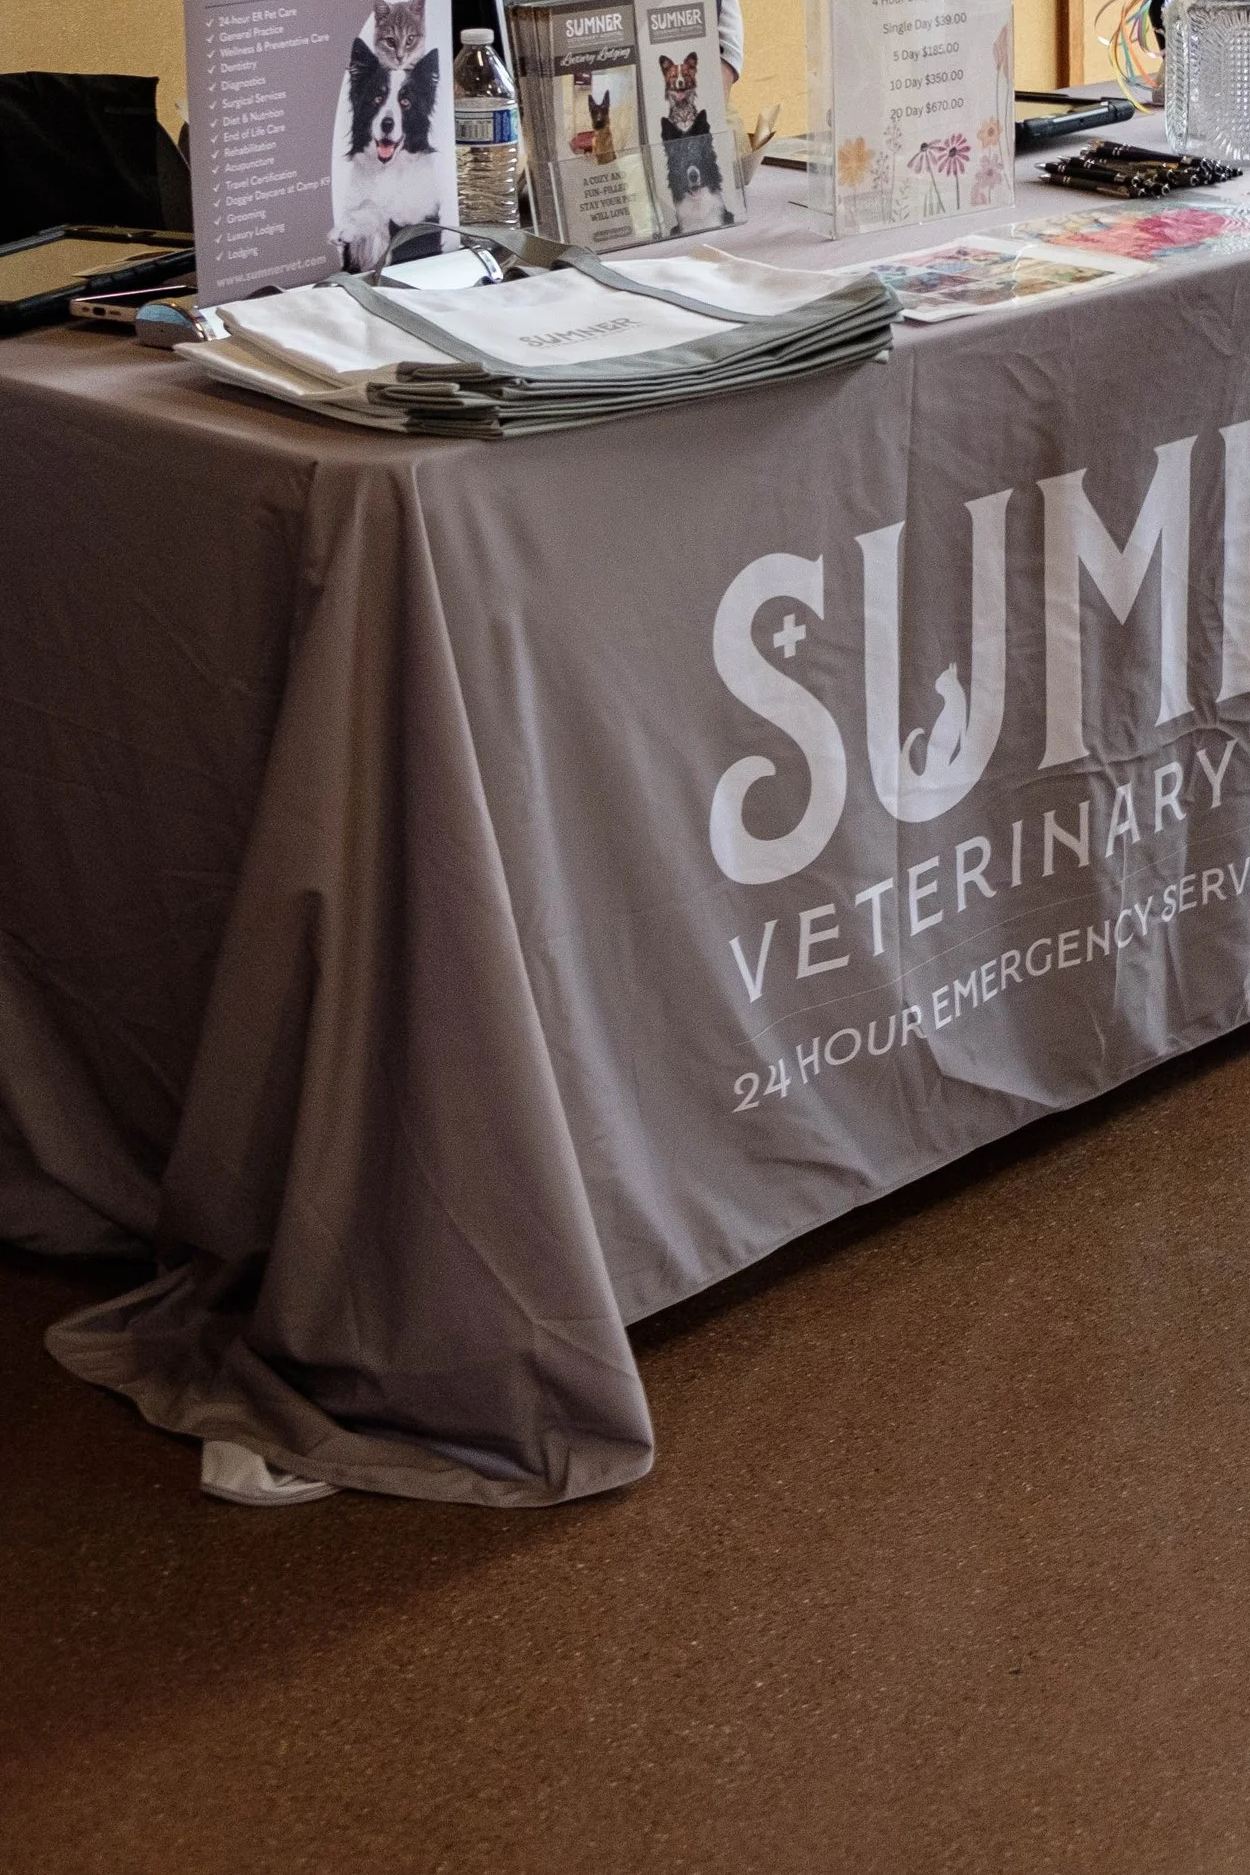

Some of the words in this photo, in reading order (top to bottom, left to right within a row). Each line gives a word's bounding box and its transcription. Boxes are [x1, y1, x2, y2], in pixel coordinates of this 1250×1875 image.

[278, 7, 297, 18] Care
[651, 9, 703, 31] SUMNER
[565, 13, 624, 38] SUMNER
[883, 20, 912, 35] Single
[915, 18, 933, 31] Day
[935, 12, 967, 27] $39.00
[219, 30, 250, 42] General
[253, 25, 284, 37] Practice
[256, 42, 263, 52] &
[311, 33, 329, 44] Care
[560, 51, 596, 67] Luxury
[893, 50, 900, 62] 5
[901, 49, 919, 62] Day
[922, 42, 960, 58] $185.00
[220, 61, 257, 74] Dentistry
[221, 77, 266, 91] Diagnostics
[890, 79, 902, 91] 10
[905, 77, 923, 90] Day
[925, 69, 964, 86] $350.00
[222, 95, 253, 109] Surgical
[255, 91, 287, 104] Services
[890, 108, 903, 120] 20
[905, 106, 924, 118] Day
[925, 97, 964, 114] $670.00
[242, 113, 248, 123] &
[223, 132, 240, 142] End
[240, 128, 250, 139] of
[251, 127, 266, 137] Life
[266, 125, 286, 135] Care
[225, 157, 275, 172] Acupuncture
[225, 178, 249, 190] Travel
[250, 170, 298, 186] Certification
[583, 178, 589, 186] A
[589, 174, 609, 185] COZY
[255, 188, 286, 201] Daycare
[296, 181, 319, 192] Camp
[580, 201, 601, 212] STAY
[610, 207, 631, 218] LOVE
[227, 210, 267, 224] Grooming
[227, 231, 254, 242] Luxury
[255, 223, 286, 236] Lodging
[228, 247, 259, 260] Lodging
[216, 256, 327, 287] www.sumnervet.com
[519, 317, 641, 347] SUMNER
[729, 738, 1237, 1003] VETERINARY
[732, 1057, 792, 1114] 24
[795, 1003, 930, 1086] HOUR
[930, 896, 1154, 1031] EMERGENCY
